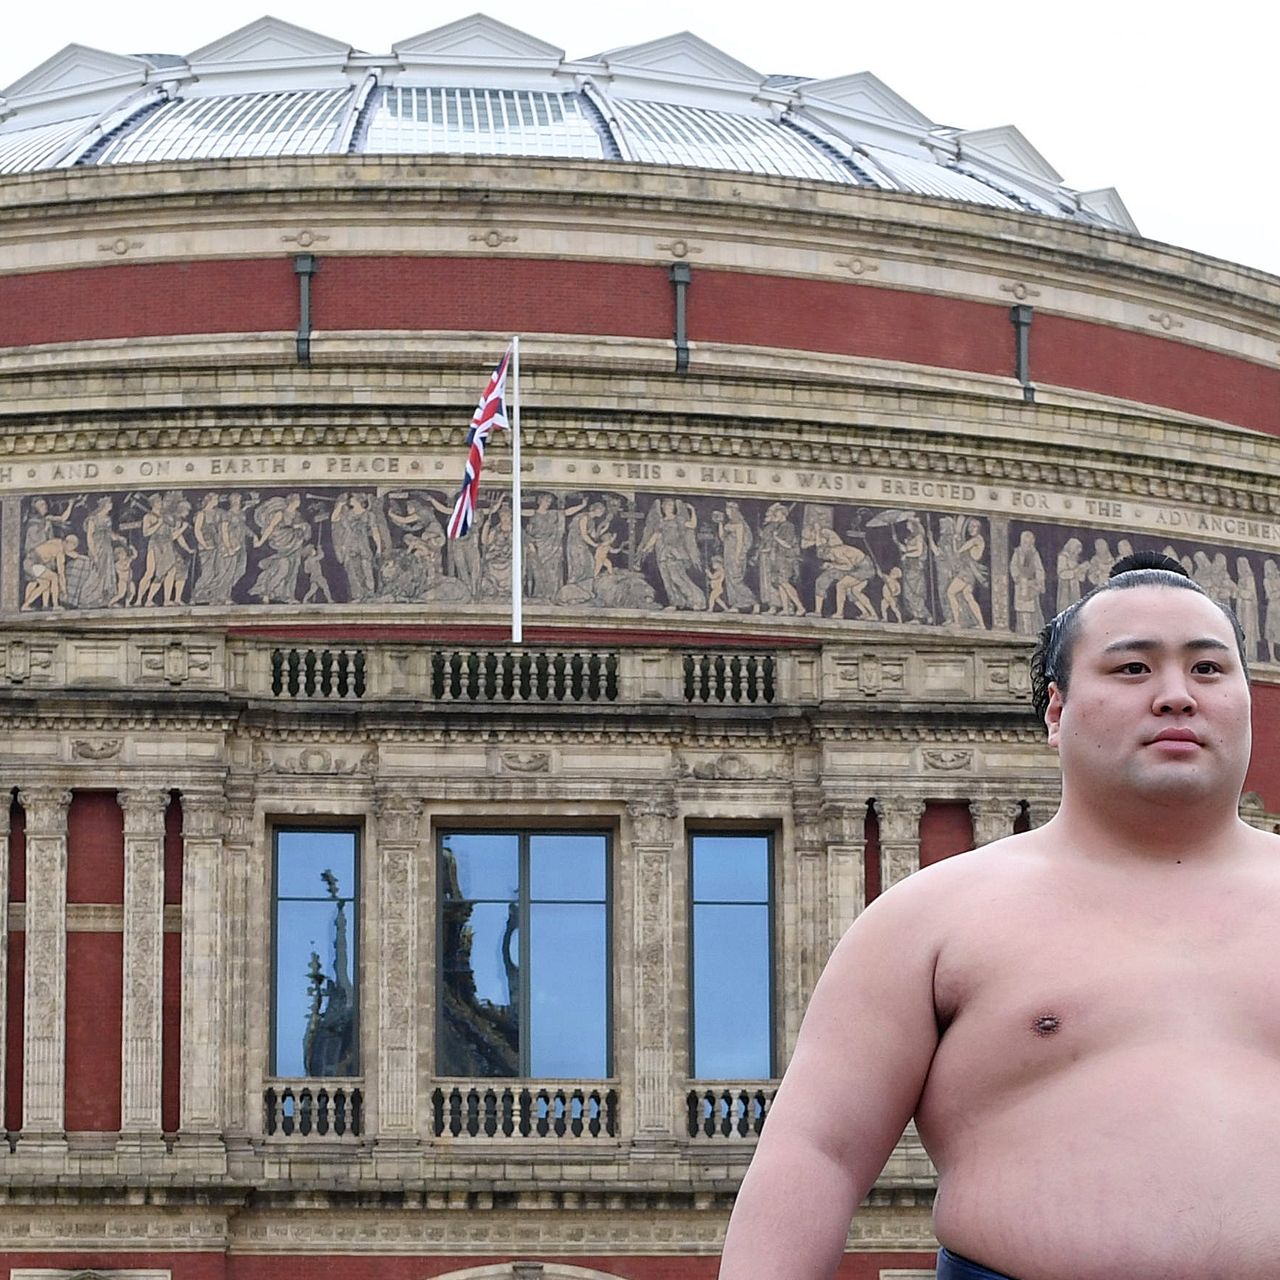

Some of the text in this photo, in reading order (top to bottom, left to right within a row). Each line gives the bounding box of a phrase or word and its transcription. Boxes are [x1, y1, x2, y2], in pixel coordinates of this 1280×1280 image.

[52, 463, 99, 481] AND
[140, 460, 171, 477] ON
[210, 458, 286, 475] EARTH
[326, 457, 400, 473] PEACE
[612, 463, 662, 480] THIS
[700, 467, 758, 486] HALL
[796, 473, 844, 491] WAS
[881, 479, 976, 501] ERECTED
[1011, 492, 1050, 509] FOR
[1085, 499, 1122, 518] THE
